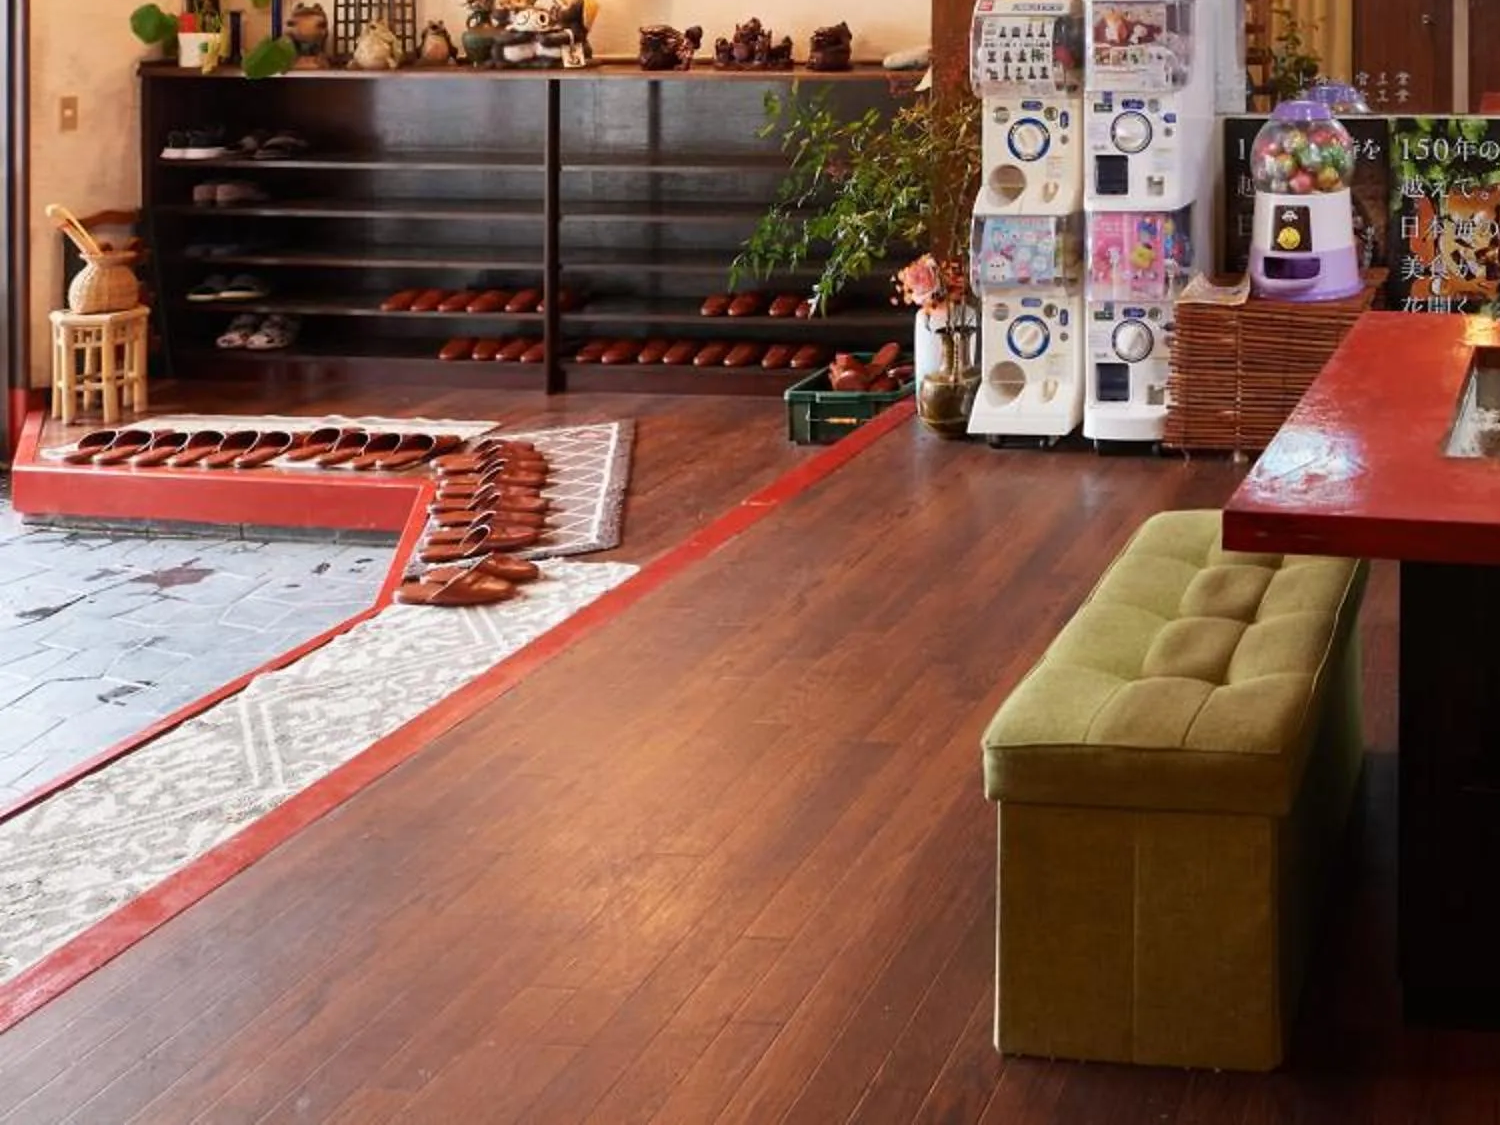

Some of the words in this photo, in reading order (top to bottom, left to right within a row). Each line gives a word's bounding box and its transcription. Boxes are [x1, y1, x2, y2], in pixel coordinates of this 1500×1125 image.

[1401, 174, 1490, 200] 越えて。
[1401, 215, 1500, 239] 日本海の
[1400, 255, 1479, 281] 美食が
